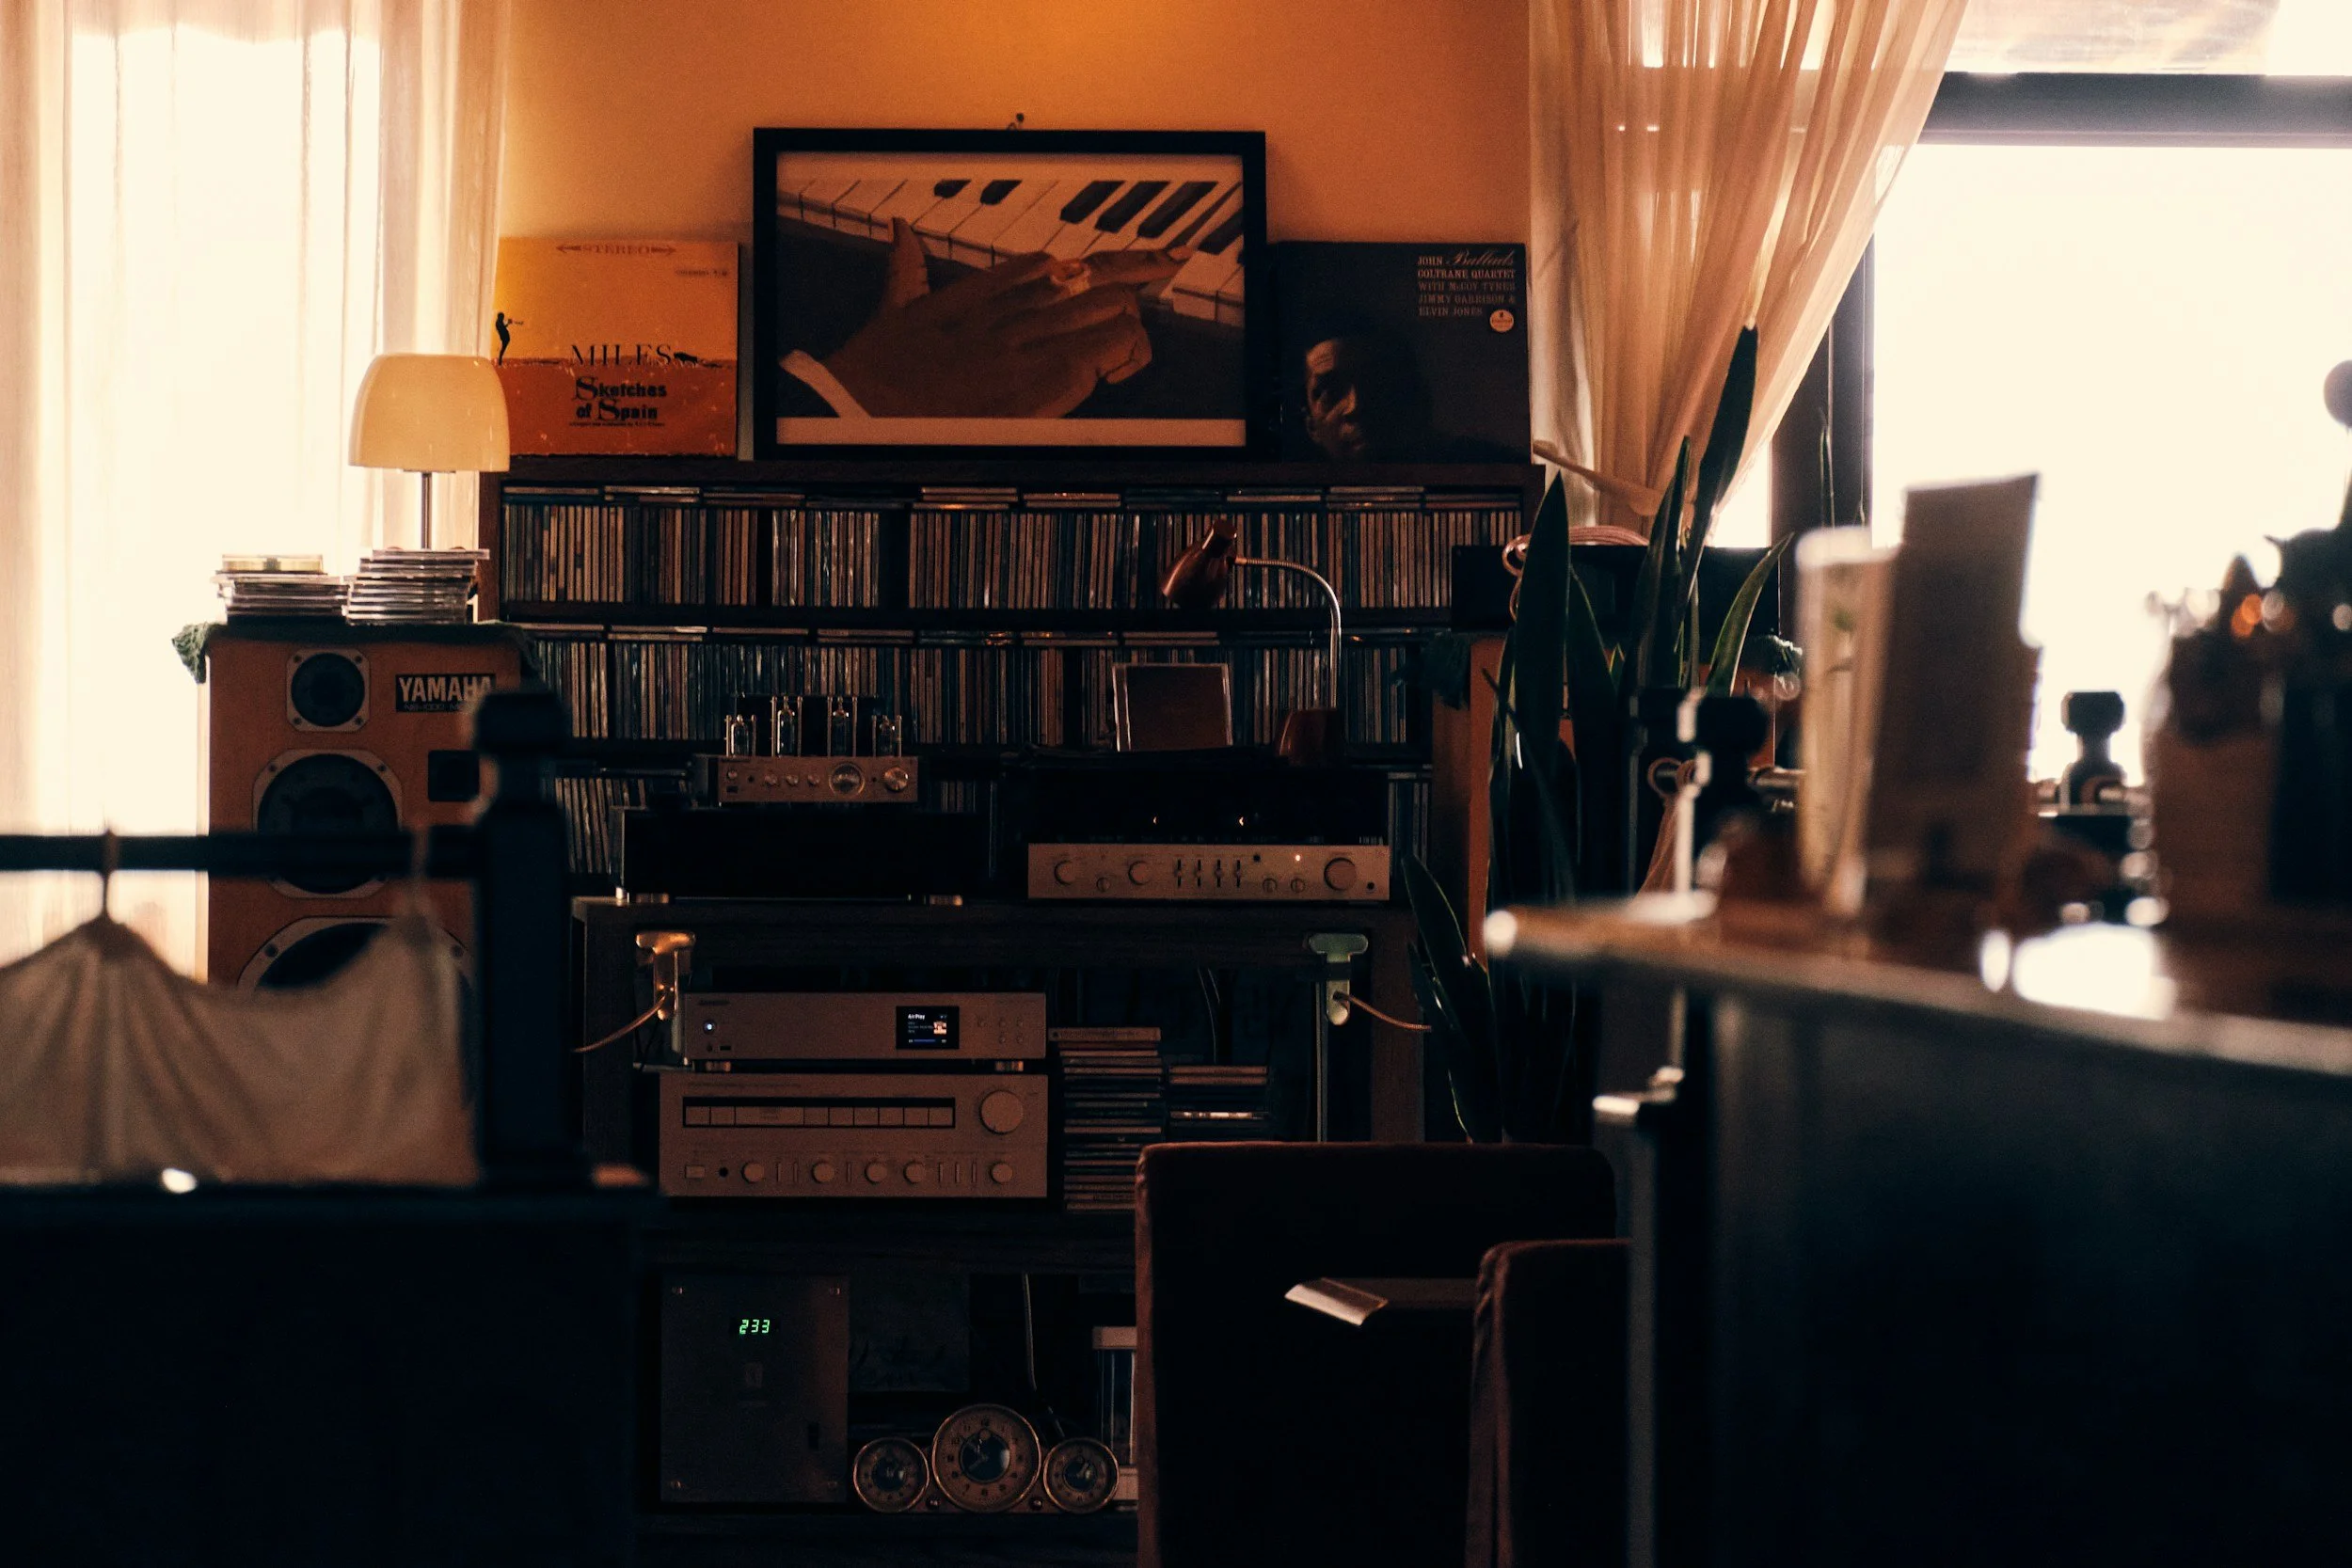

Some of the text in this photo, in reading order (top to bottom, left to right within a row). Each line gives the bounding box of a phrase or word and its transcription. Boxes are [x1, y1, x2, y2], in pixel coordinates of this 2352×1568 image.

[1417, 247, 1516, 266] JOHN Ballads
[1417, 268, 1517, 279] COLTRANE QUARTET
[1418, 281, 1445, 292] WITH
[1418, 294, 1451, 304] JIMMY
[1418, 307, 1484, 317] ELVIN JONES
[571, 344, 672, 366] MILES
[574, 375, 667, 401] Sketches
[576, 398, 658, 420] of Spain
[398, 675, 491, 702] YAMAHA
[907, 1013, 926, 1022] AirPlay
[739, 1319, 771, 1335] 233
